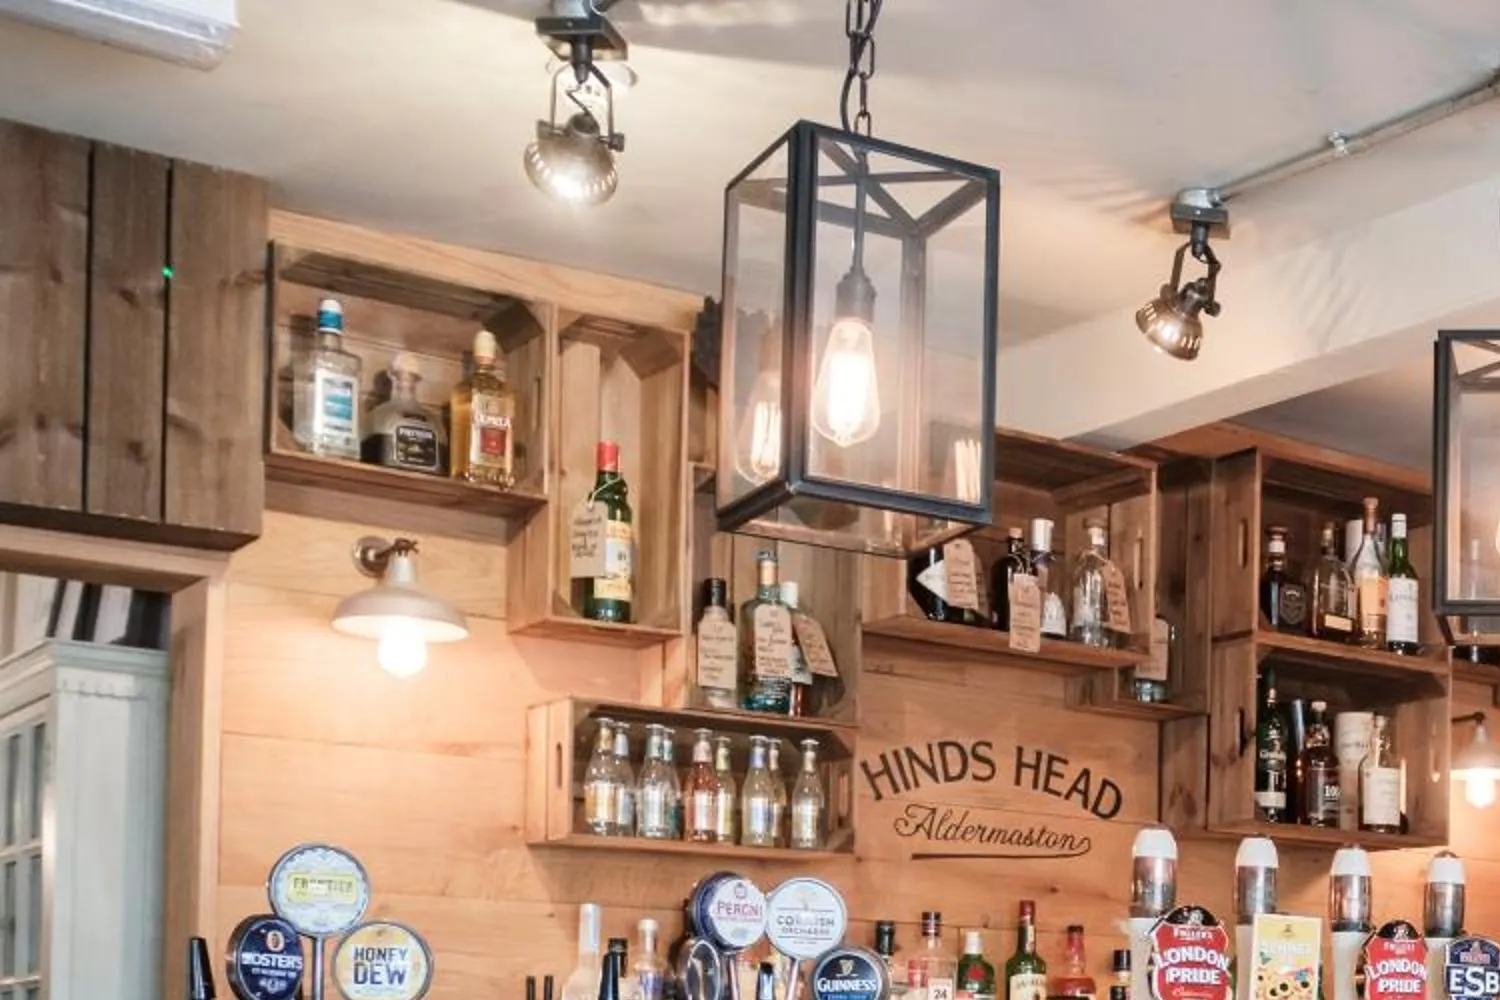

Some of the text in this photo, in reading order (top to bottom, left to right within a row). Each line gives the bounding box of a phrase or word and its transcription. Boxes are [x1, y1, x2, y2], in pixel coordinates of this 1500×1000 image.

[859, 740, 1124, 821] HINDS HEAD
[893, 803, 1092, 853] Aldermaston
[716, 901, 764, 919] PERONI
[354, 945, 409, 962] HONEY
[1153, 944, 1230, 971] LONDON
[353, 962, 407, 986] DEW
[1166, 967, 1222, 985] PRIDE
[1364, 957, 1428, 981] LONDON
[817, 977, 878, 992] GUINNESS
[1377, 978, 1421, 994] PRIDE
[1449, 965, 1500, 999] ESB
